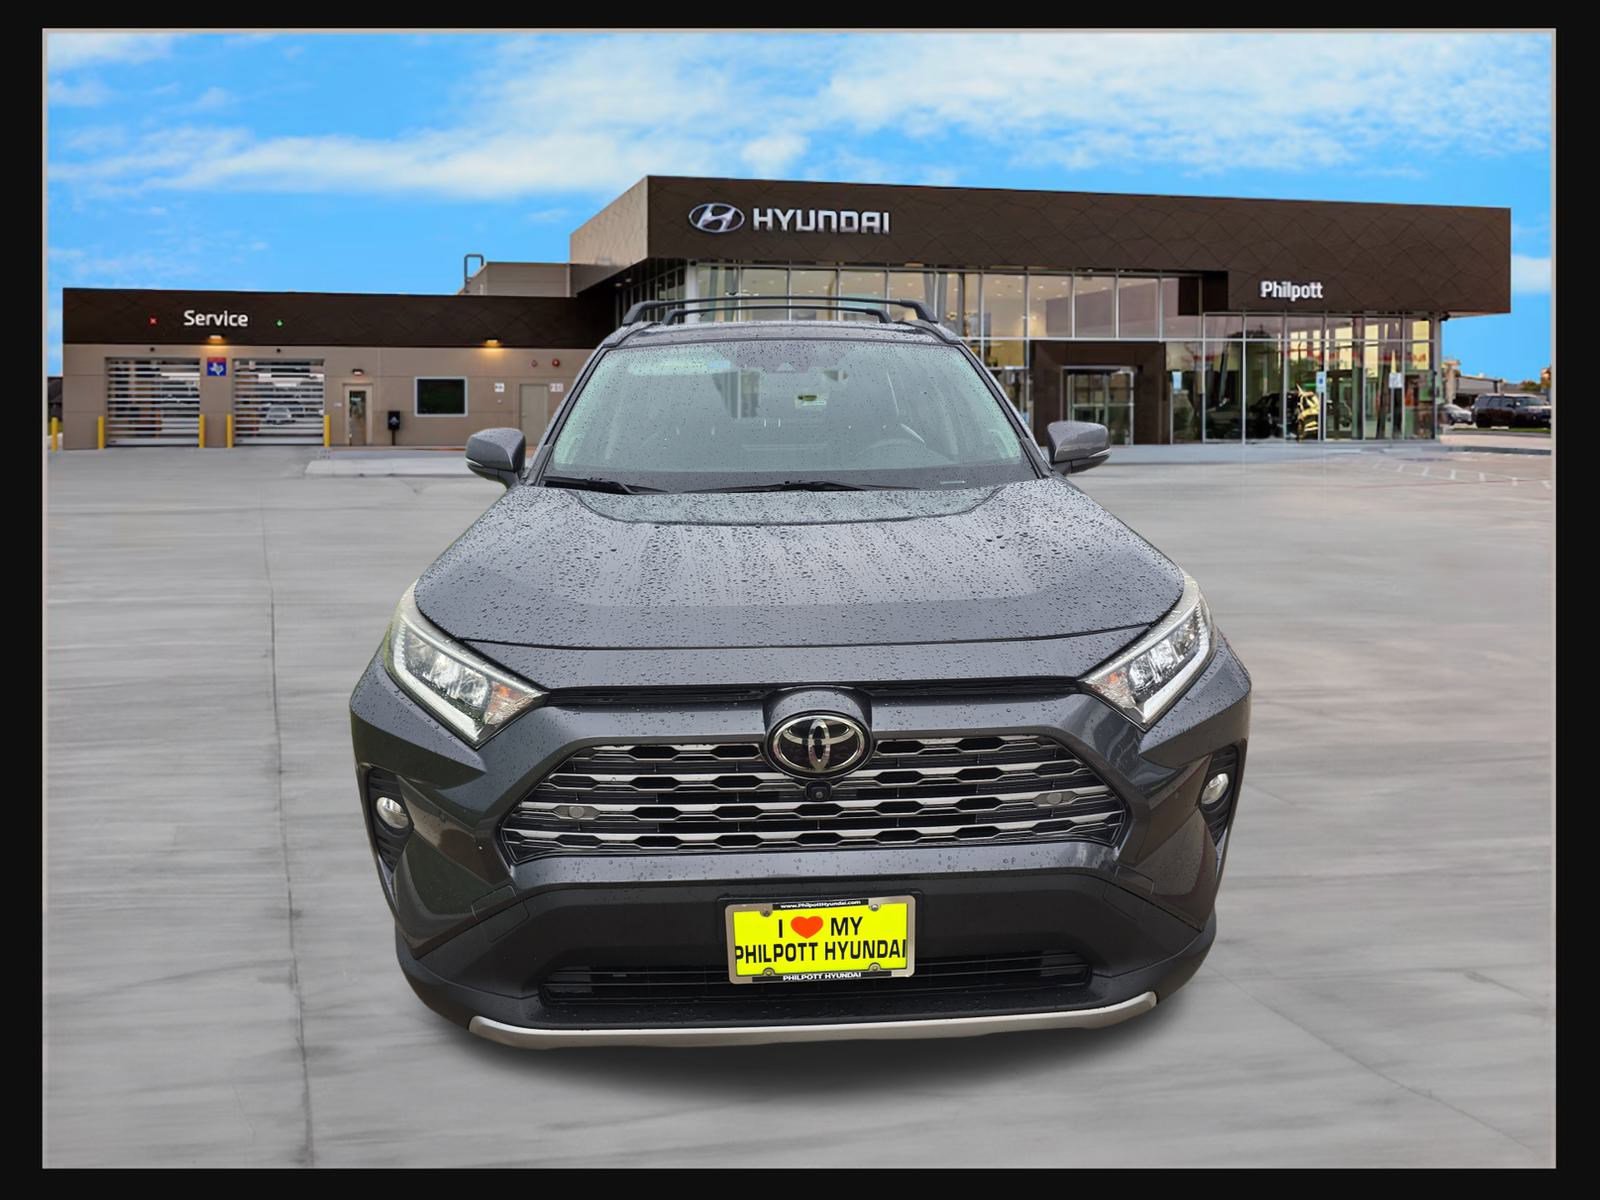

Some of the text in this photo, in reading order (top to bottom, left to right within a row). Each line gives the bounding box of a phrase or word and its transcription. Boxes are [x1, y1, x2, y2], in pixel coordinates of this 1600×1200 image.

[753, 207, 890, 234] HYUNDAI
[1260, 280, 1323, 302] Philpott
[183, 309, 249, 327] Service
[778, 916, 863, 938] I MY
[735, 939, 906, 964] PHILPOTT HYUNDAI
[783, 971, 862, 981] PHILPOTT HYUNDAI
